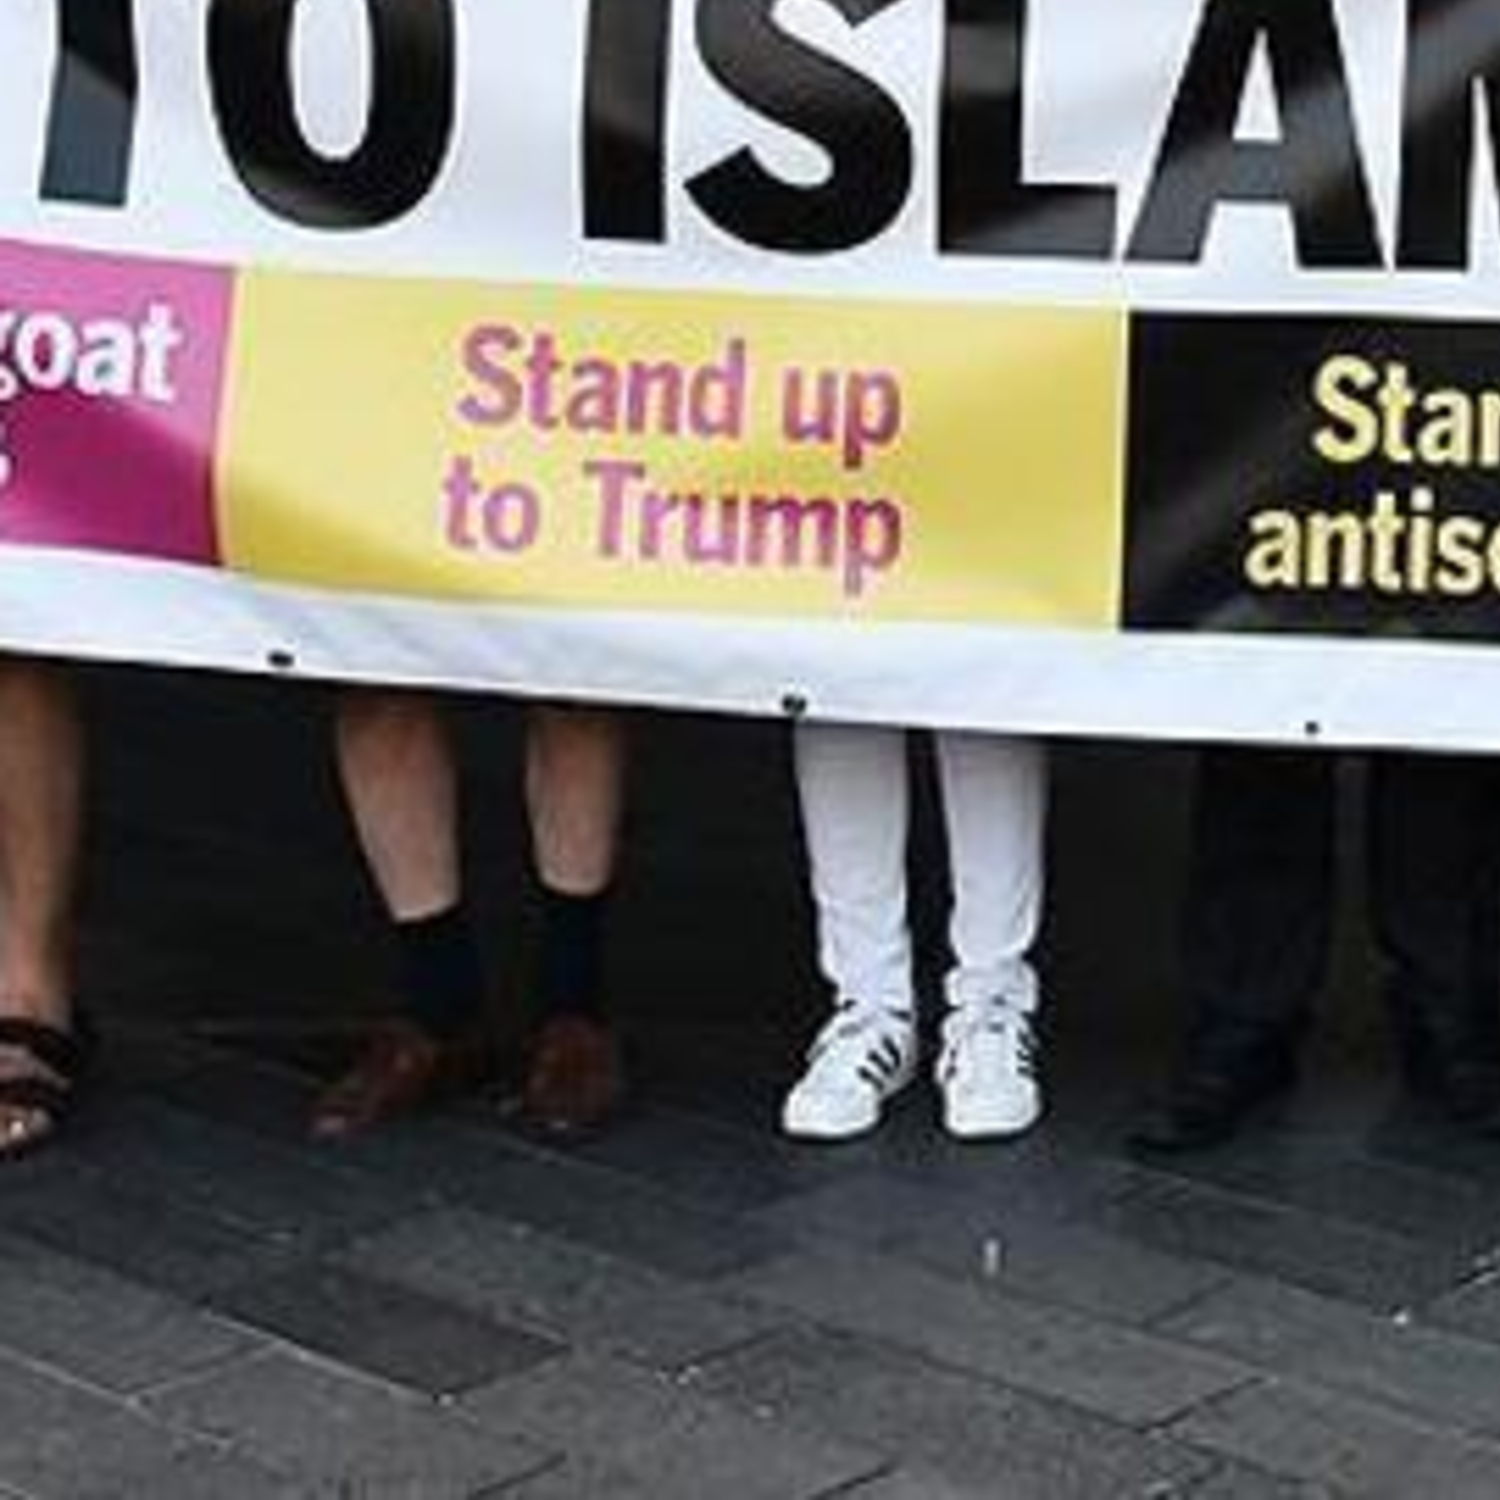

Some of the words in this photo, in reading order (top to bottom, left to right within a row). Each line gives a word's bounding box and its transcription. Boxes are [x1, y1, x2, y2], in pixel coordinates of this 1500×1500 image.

[457, 324, 746, 440] Stand
[783, 368, 901, 471] up
[443, 455, 541, 553] to
[585, 460, 903, 596] Trump
